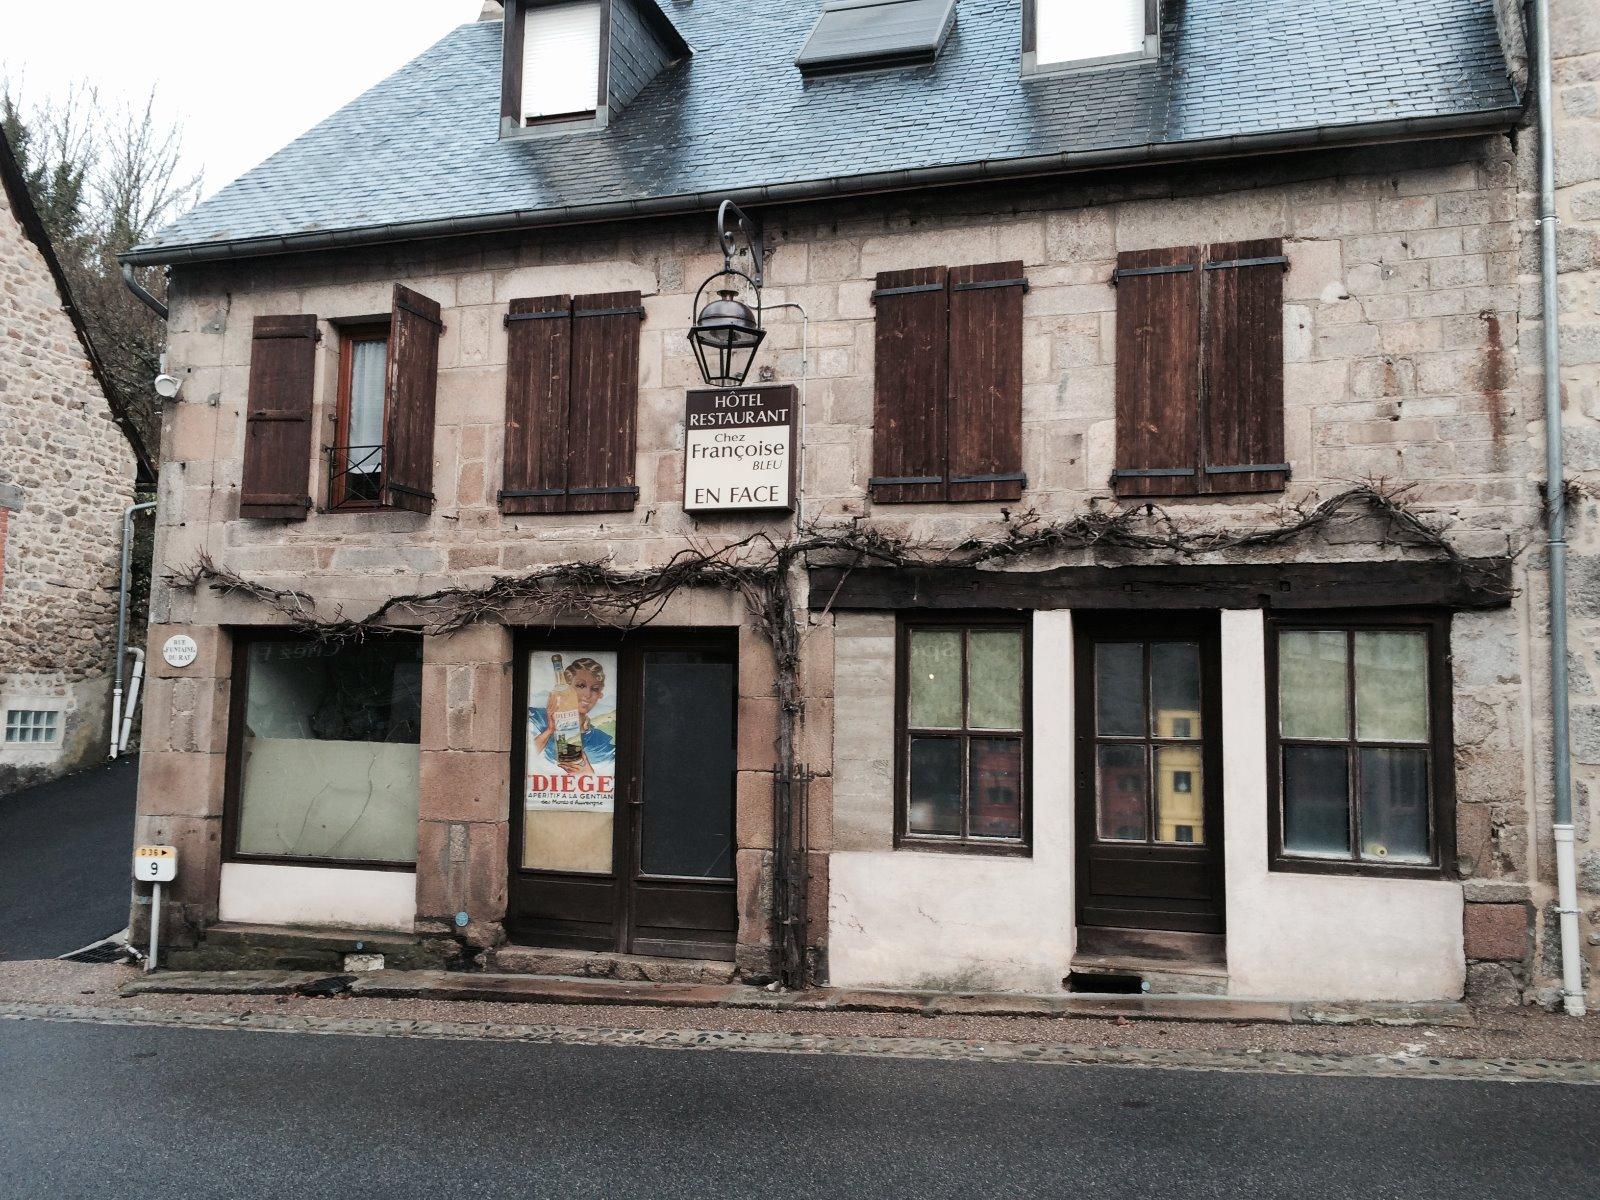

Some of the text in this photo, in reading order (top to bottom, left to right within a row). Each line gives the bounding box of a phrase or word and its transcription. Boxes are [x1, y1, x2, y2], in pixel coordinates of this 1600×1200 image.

[715, 391, 764, 408] HÔTEL
[690, 409, 788, 426] RESTAURANT
[714, 433, 746, 442] Chez
[692, 441, 784, 461] Françoise
[752, 460, 782, 470] BLEU
[695, 486, 779, 504] EN FACE
[151, 862, 158, 875] 9
